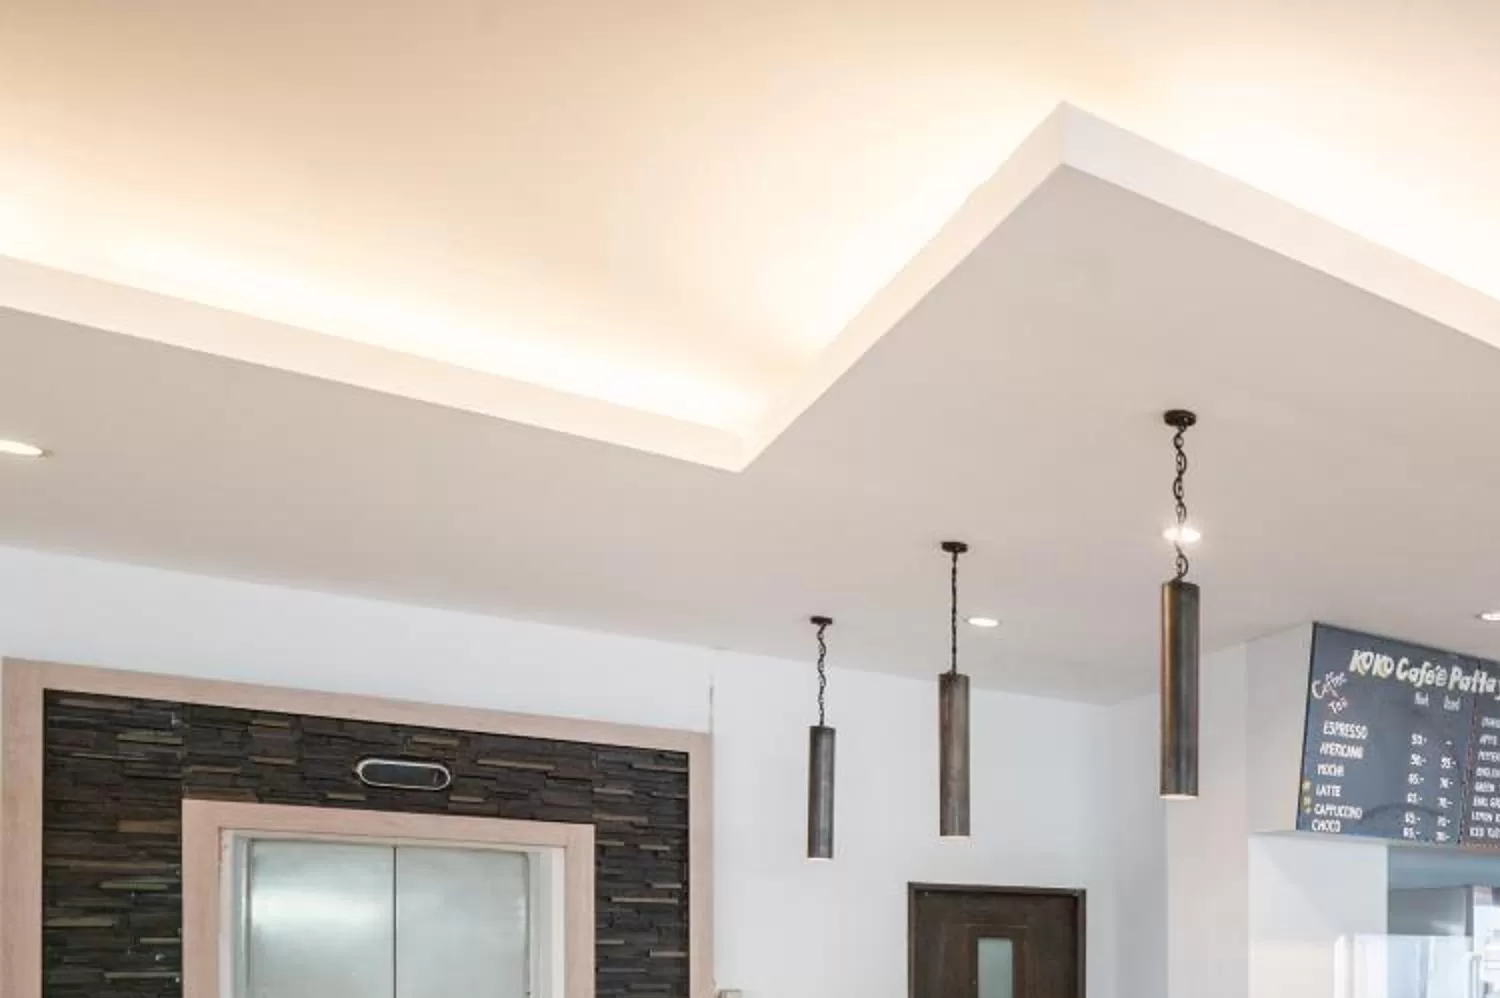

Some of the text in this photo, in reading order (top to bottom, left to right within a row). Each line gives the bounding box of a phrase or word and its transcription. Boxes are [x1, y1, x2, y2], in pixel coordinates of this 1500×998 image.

[1348, 649, 1395, 679] KOKO
[1323, 720, 1369, 740] ESPRESSO
[1315, 784, 1342, 797] LATTE
